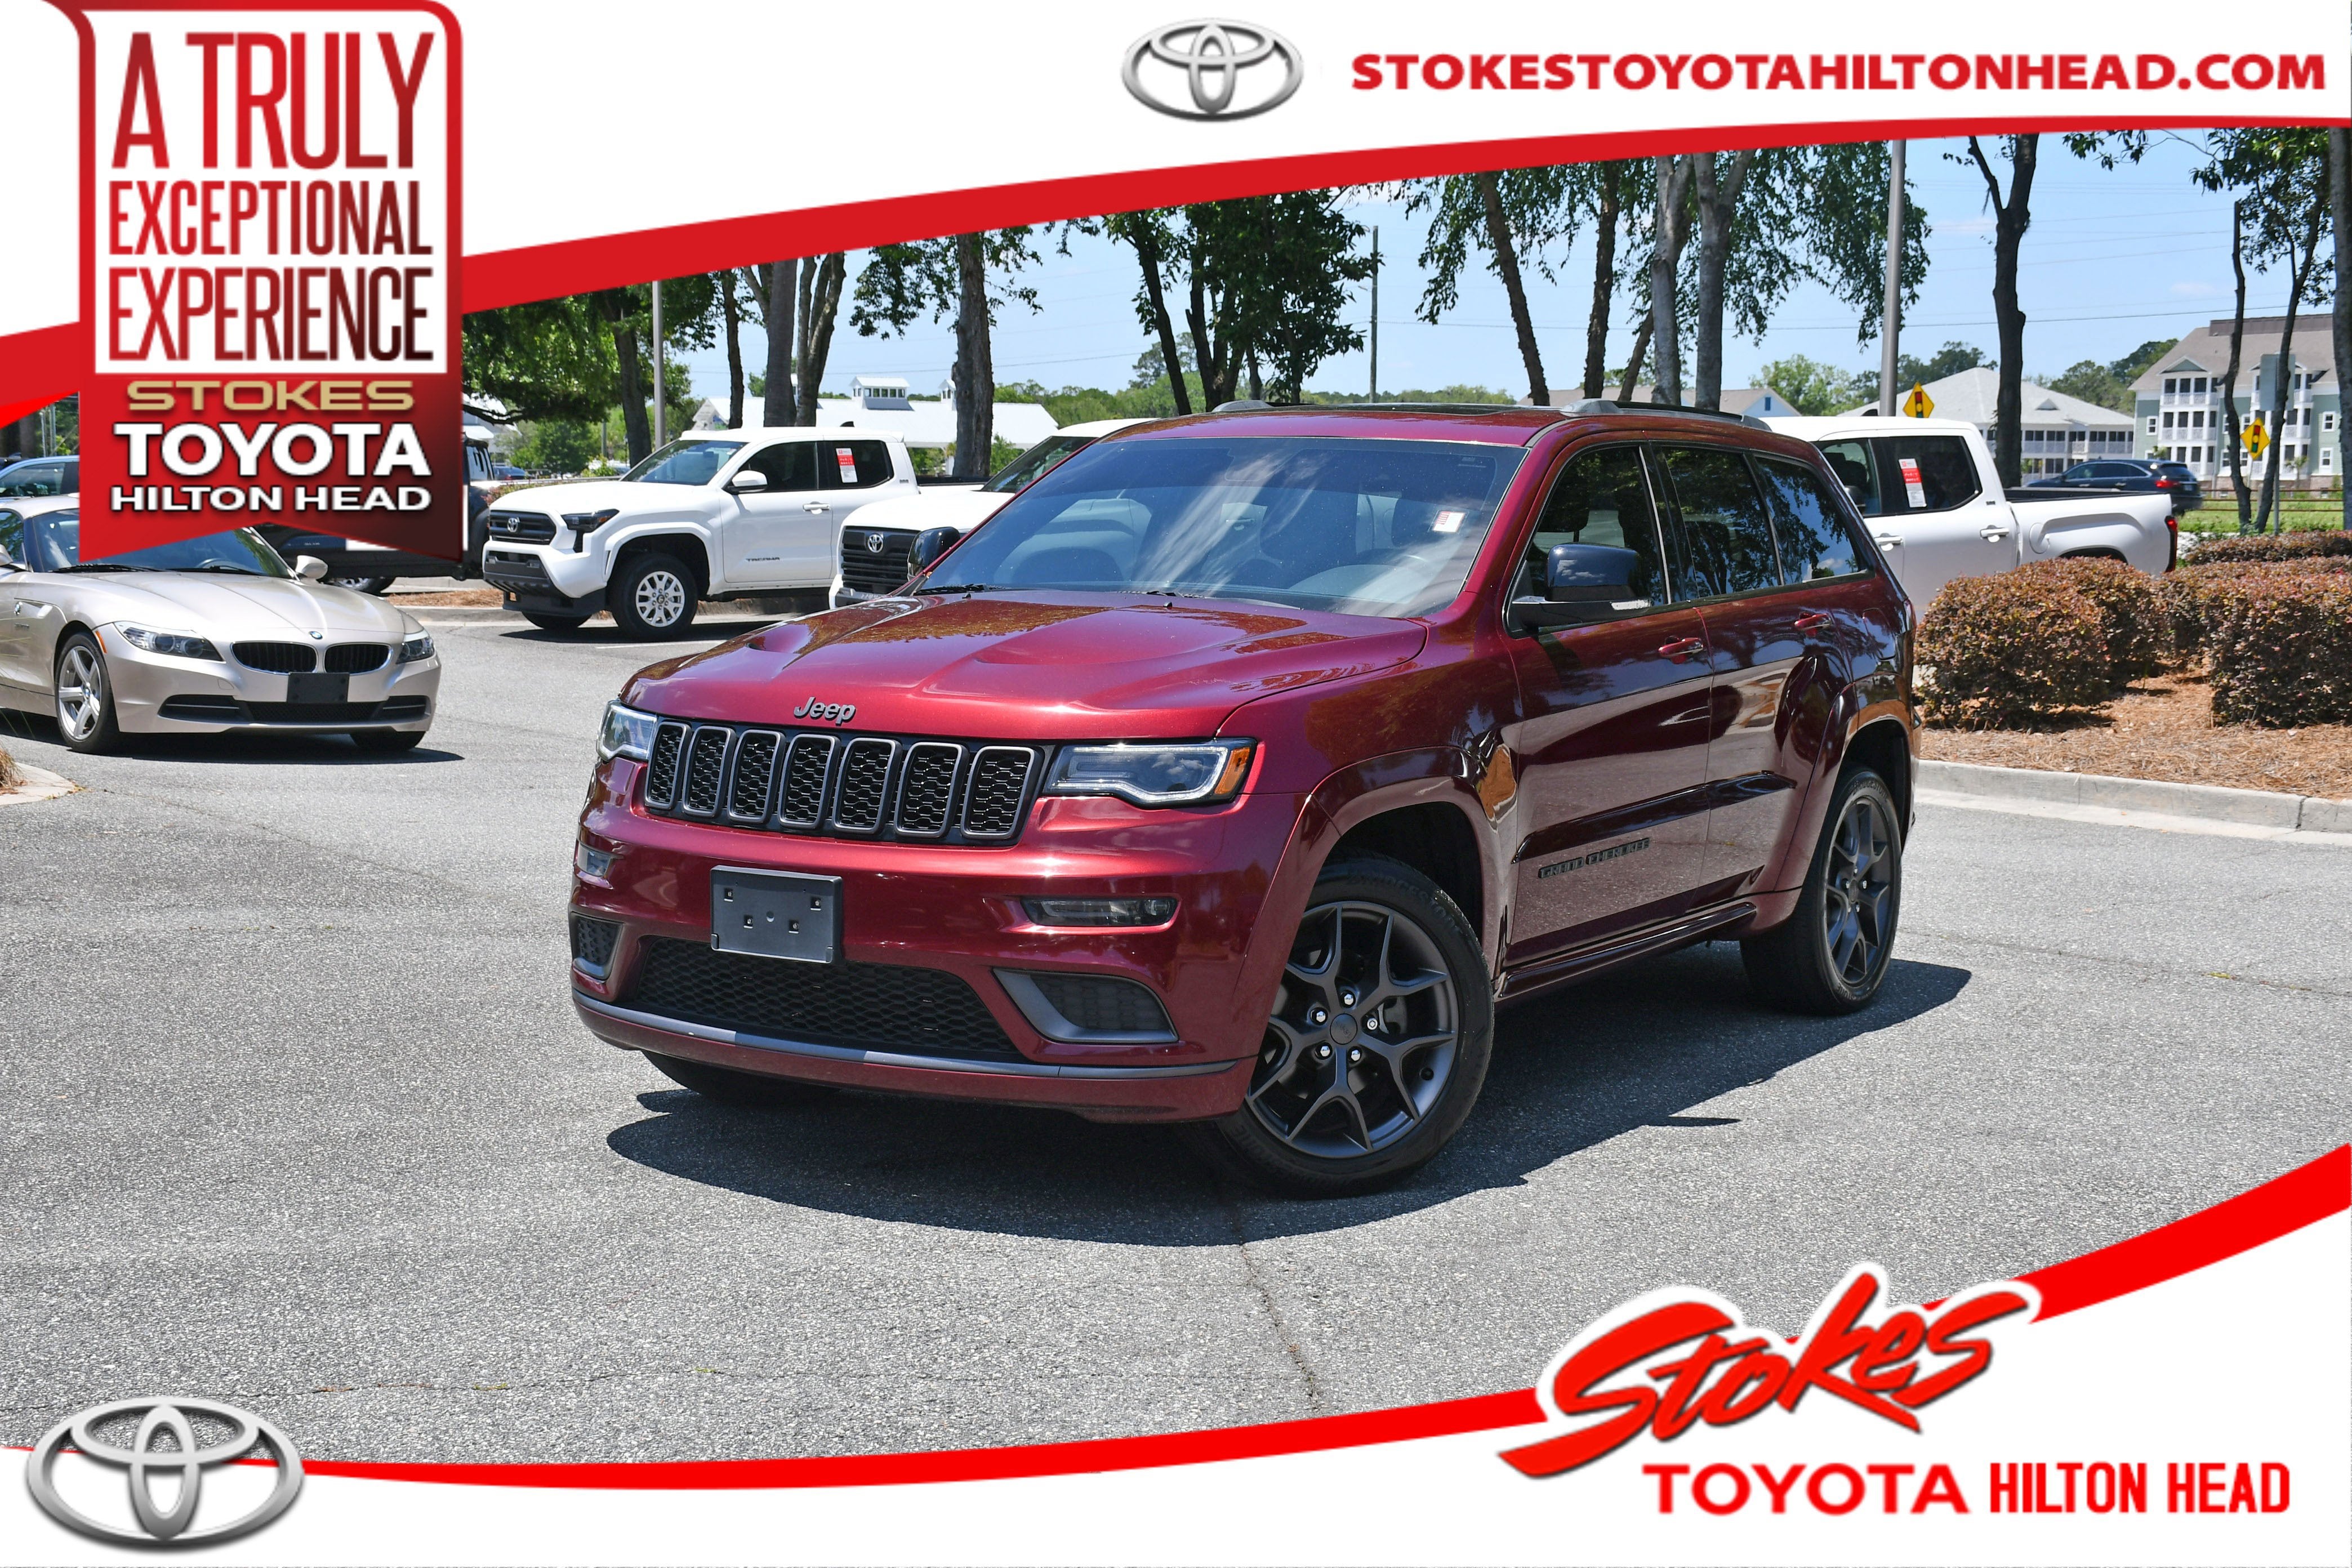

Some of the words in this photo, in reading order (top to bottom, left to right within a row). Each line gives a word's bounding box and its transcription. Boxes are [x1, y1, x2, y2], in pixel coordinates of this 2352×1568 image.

[794, 696, 856, 727] Jeep
[1538, 857, 1585, 879] GRAND
[1585, 838, 1650, 865] CHEROKEE
